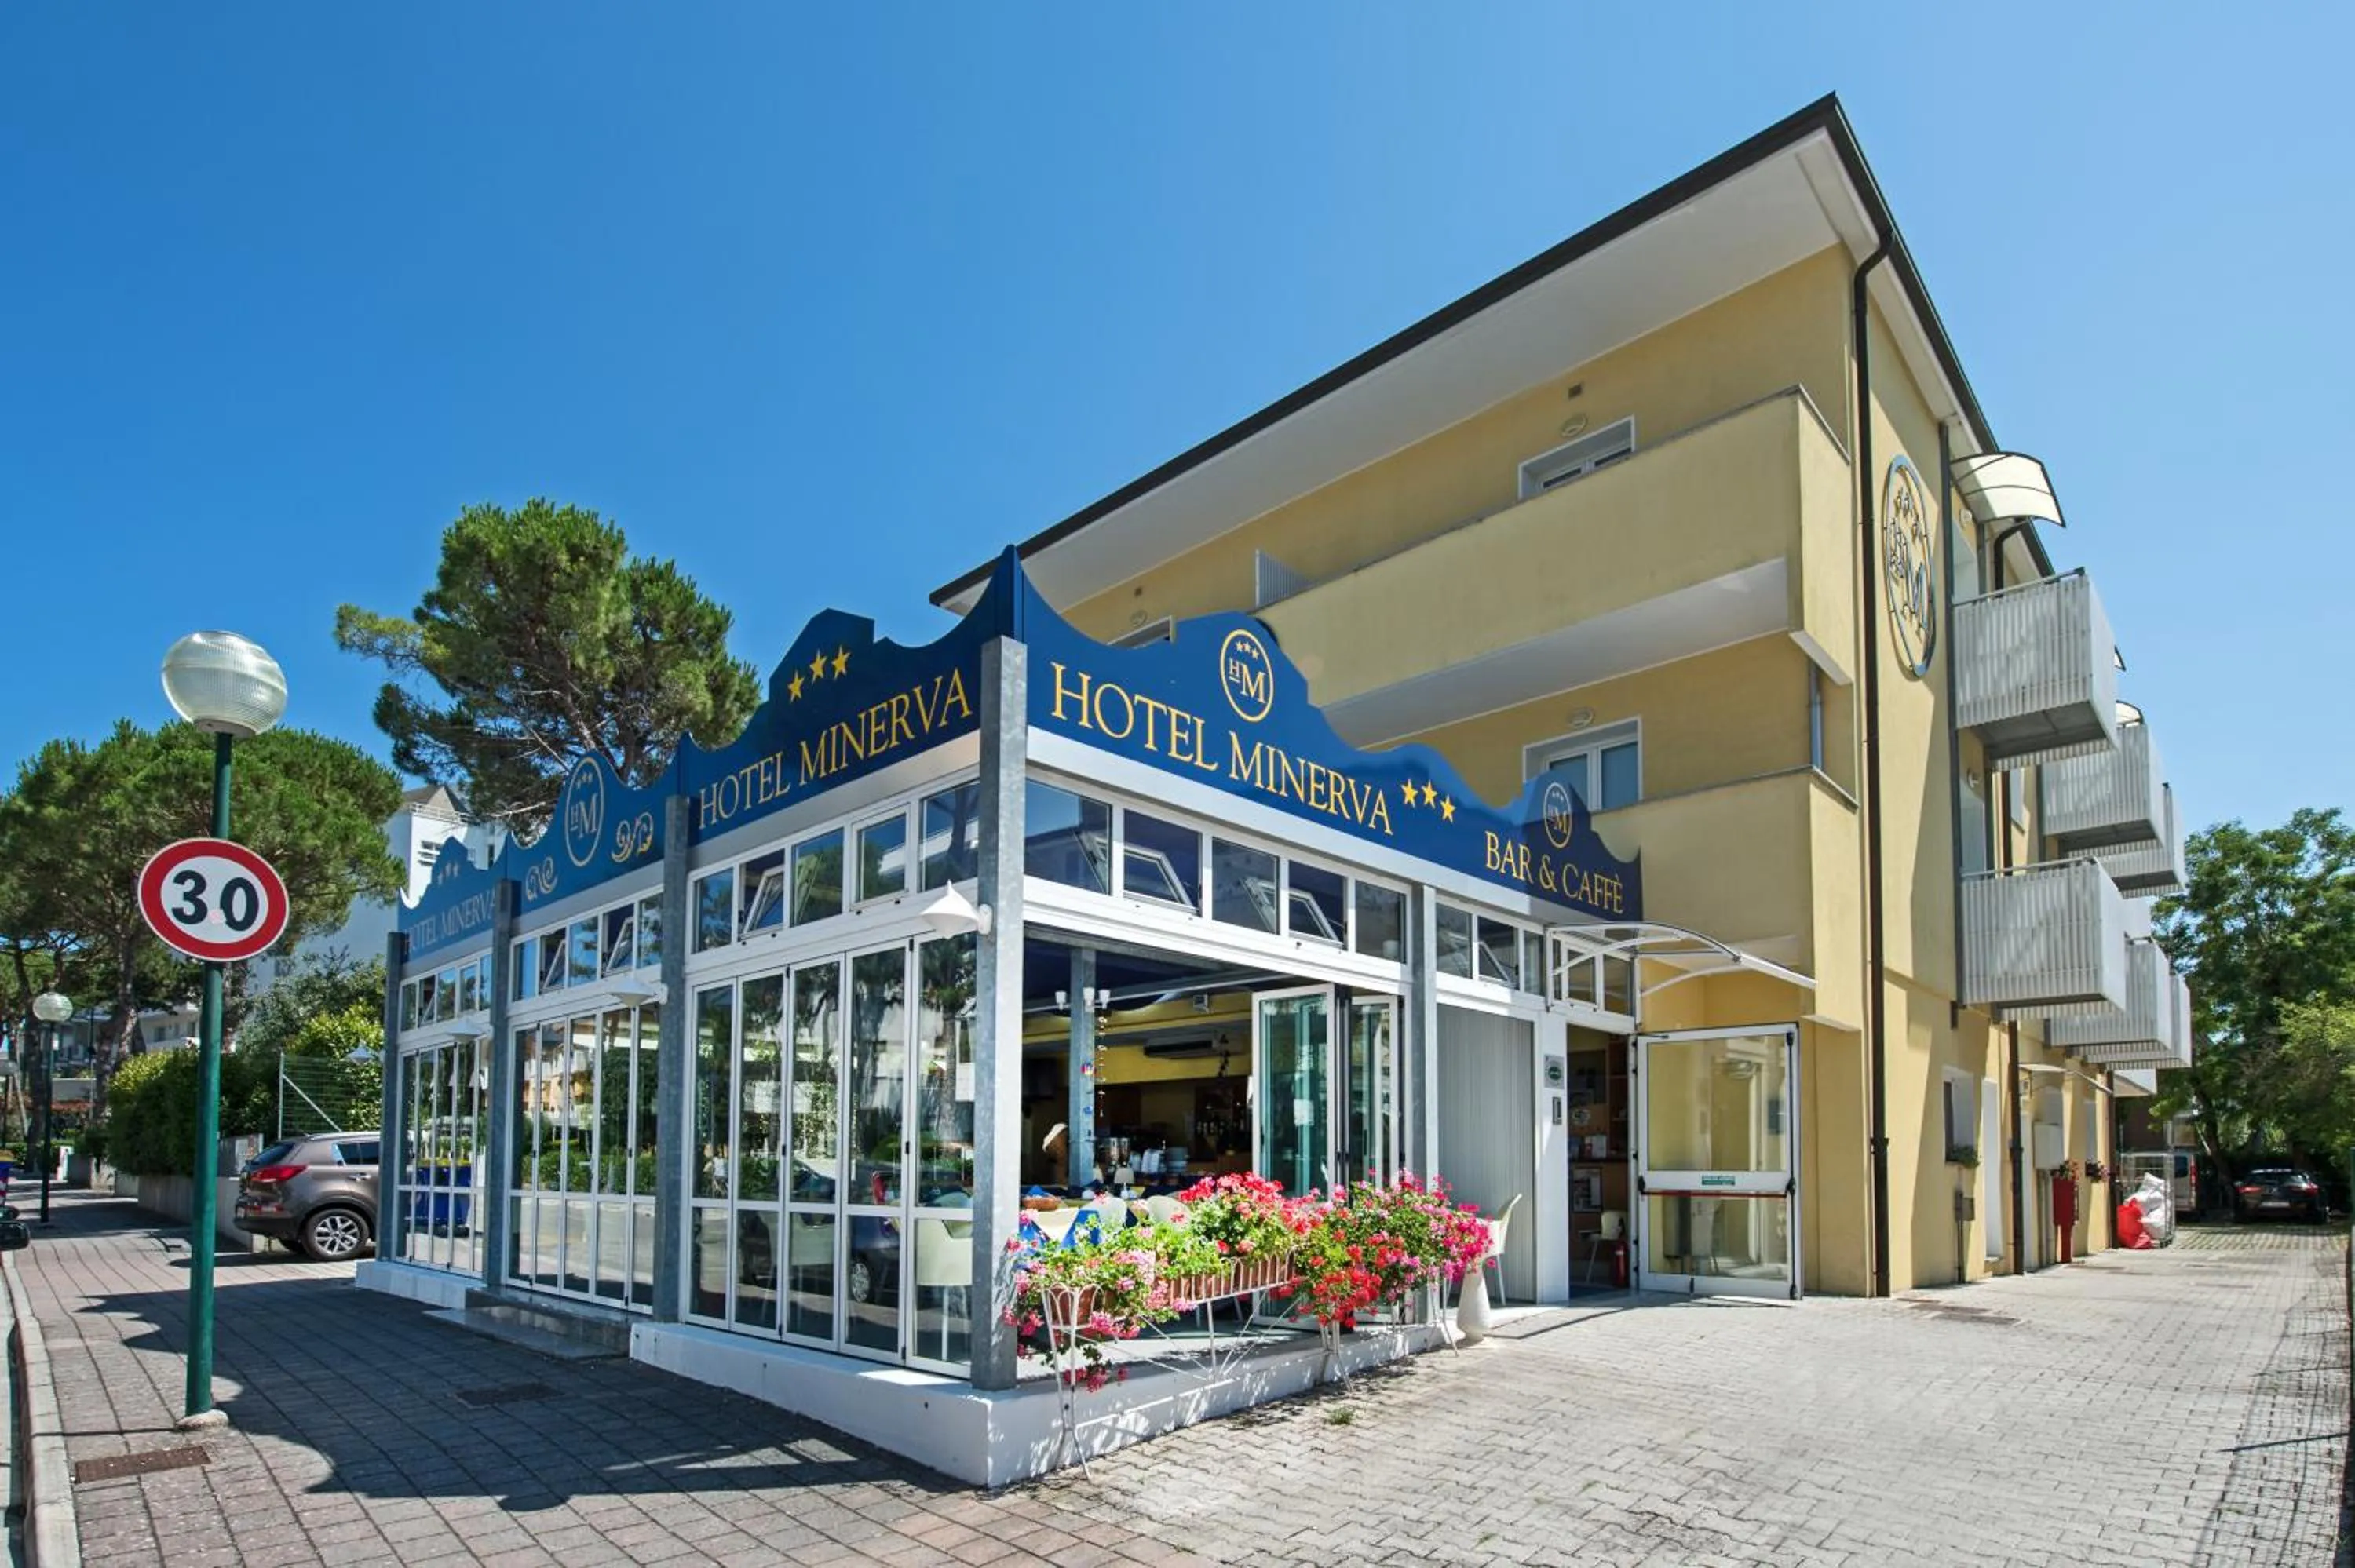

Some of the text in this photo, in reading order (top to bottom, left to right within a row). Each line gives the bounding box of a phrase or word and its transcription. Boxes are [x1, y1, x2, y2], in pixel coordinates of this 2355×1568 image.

[698, 667, 973, 830] HOTEL MINERVA
[1050, 662, 1393, 835] HOTEL MINERVA
[171, 869, 260, 932] 30
[1484, 830, 1624, 914] BAR & CAFFÈ
